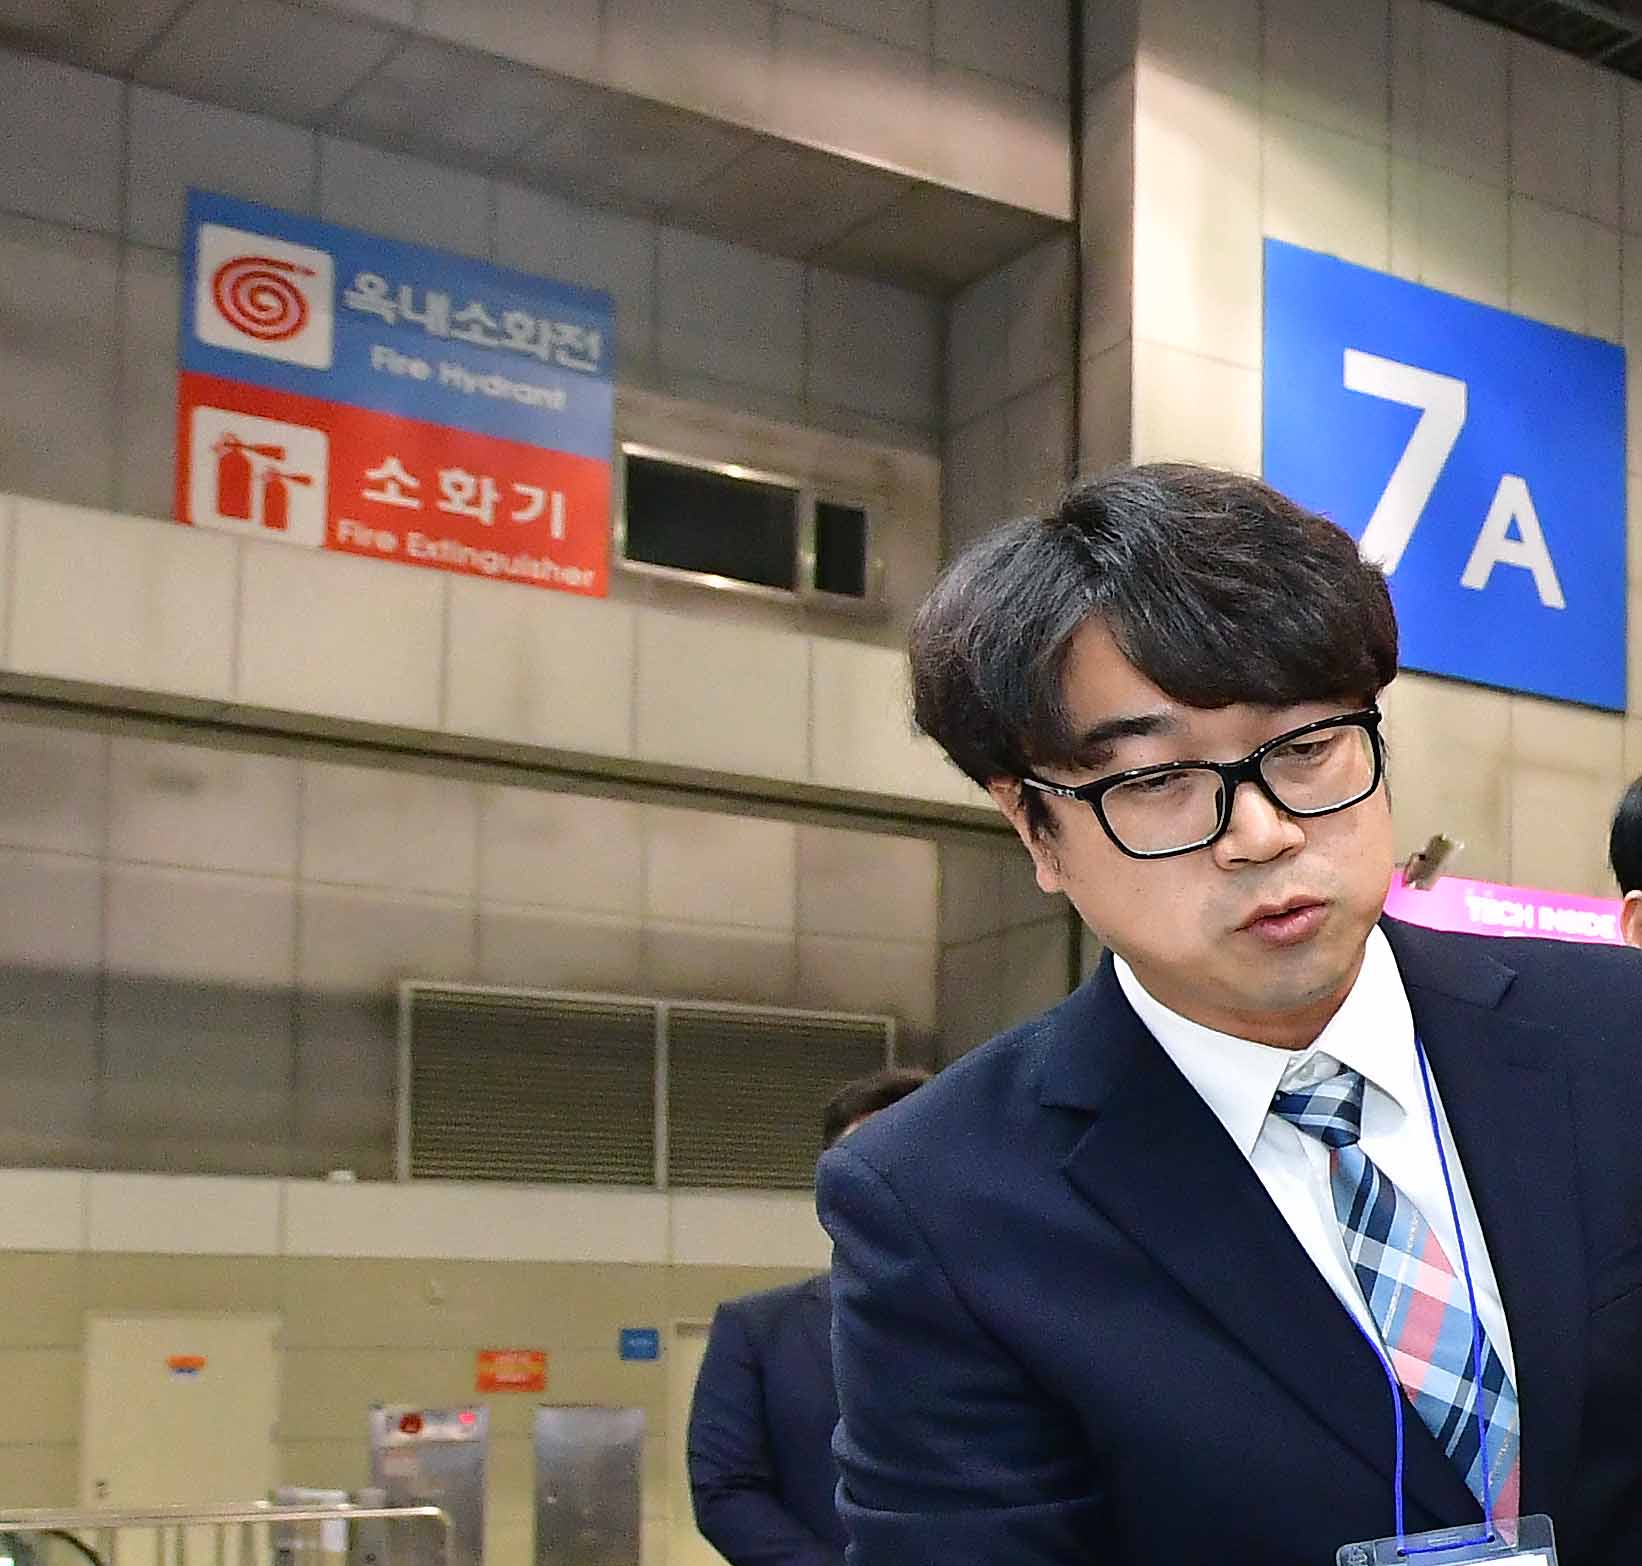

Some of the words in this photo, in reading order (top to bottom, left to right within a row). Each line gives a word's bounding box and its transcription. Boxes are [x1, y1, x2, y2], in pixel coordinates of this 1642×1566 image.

[342, 270, 601, 373] 옥내소화전
[370, 345, 432, 383] Fire
[440, 363, 568, 412] Hydrant
[360, 454, 568, 541] 소화기
[337, 518, 400, 554] Fire
[407, 530, 596, 589] Extinguisher
